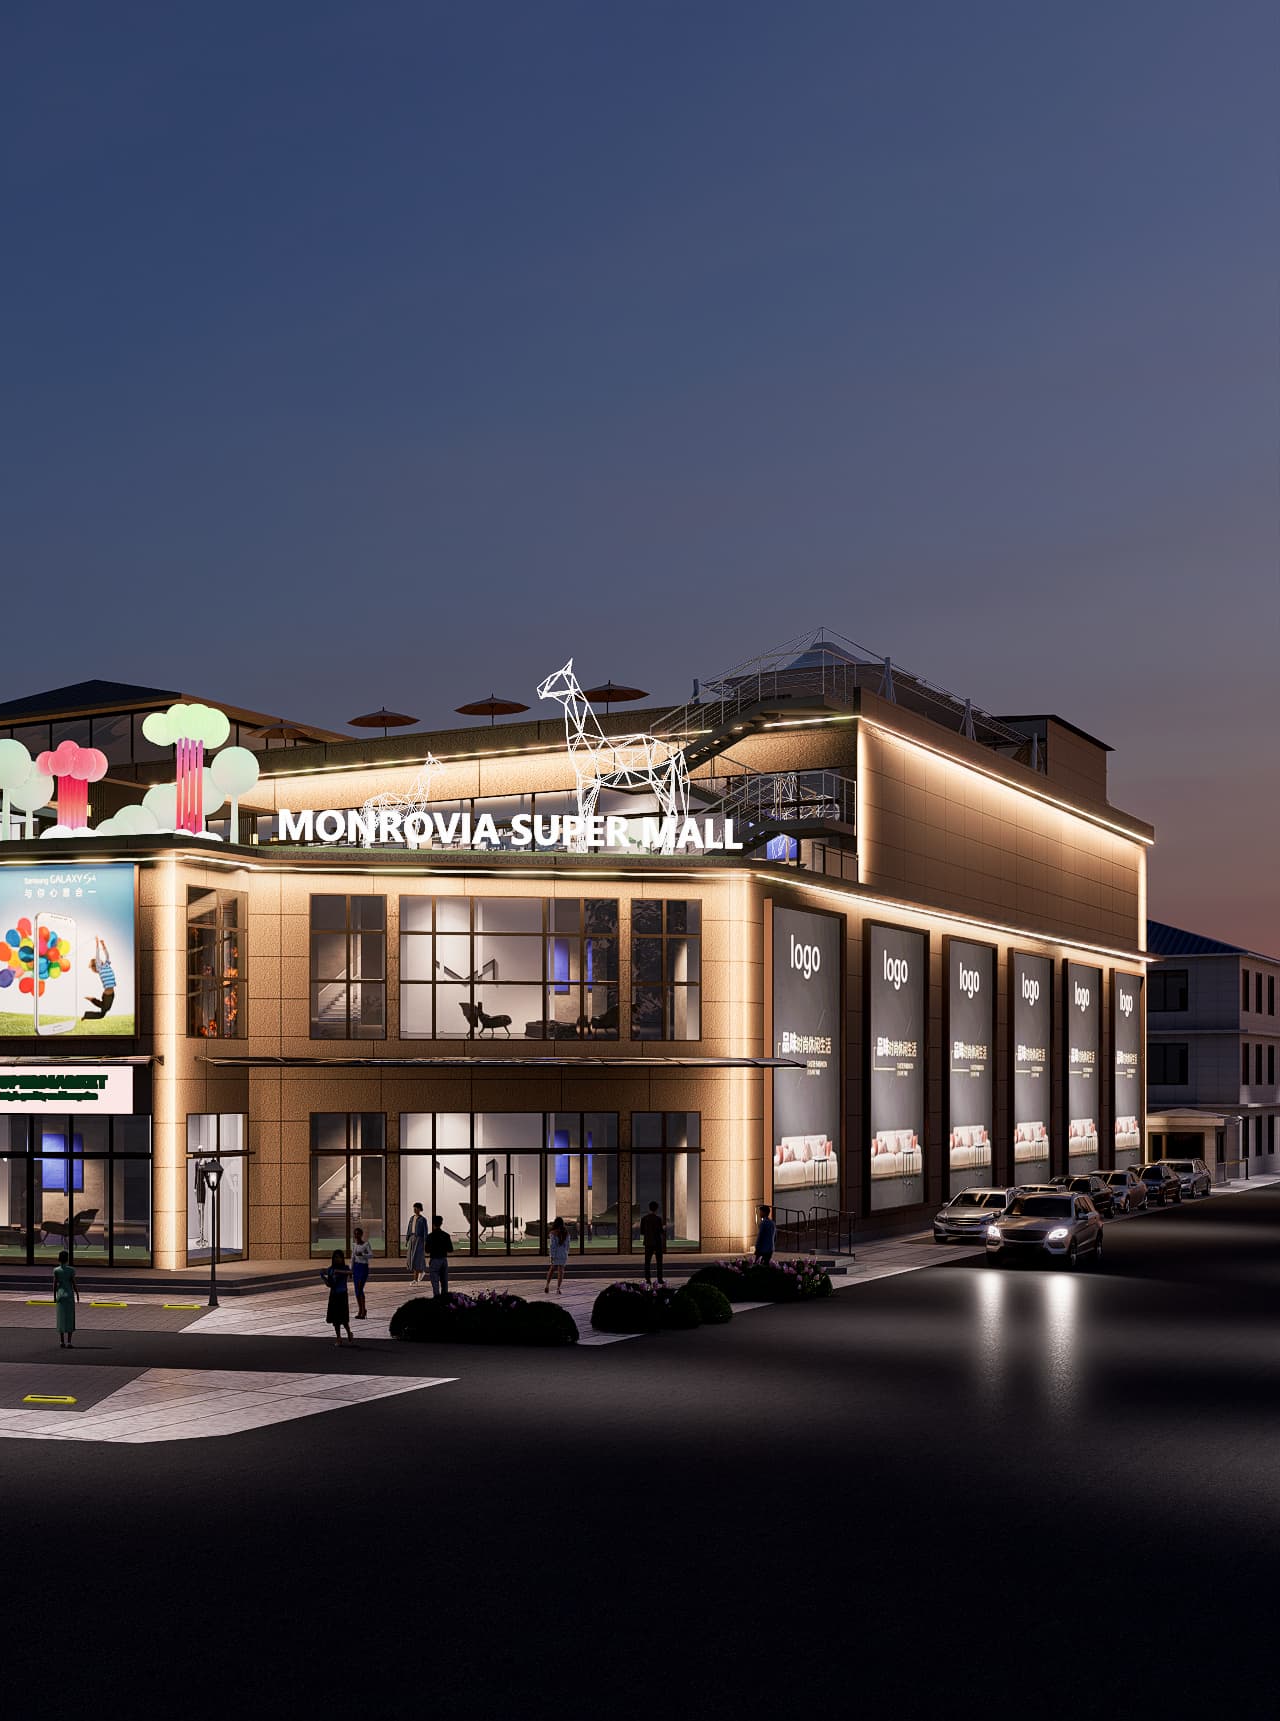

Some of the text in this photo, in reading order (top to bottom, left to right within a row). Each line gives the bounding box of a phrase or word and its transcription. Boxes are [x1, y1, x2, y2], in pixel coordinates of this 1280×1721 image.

[277, 809, 743, 850] MONROVIA SUPER MALL
[49, 874, 83, 884] GALAXY
[790, 933, 821, 980] logo
[883, 949, 909, 991] logo
[959, 961, 980, 999] logo
[1022, 972, 1040, 1006] logo
[1074, 980, 1090, 1012] logo
